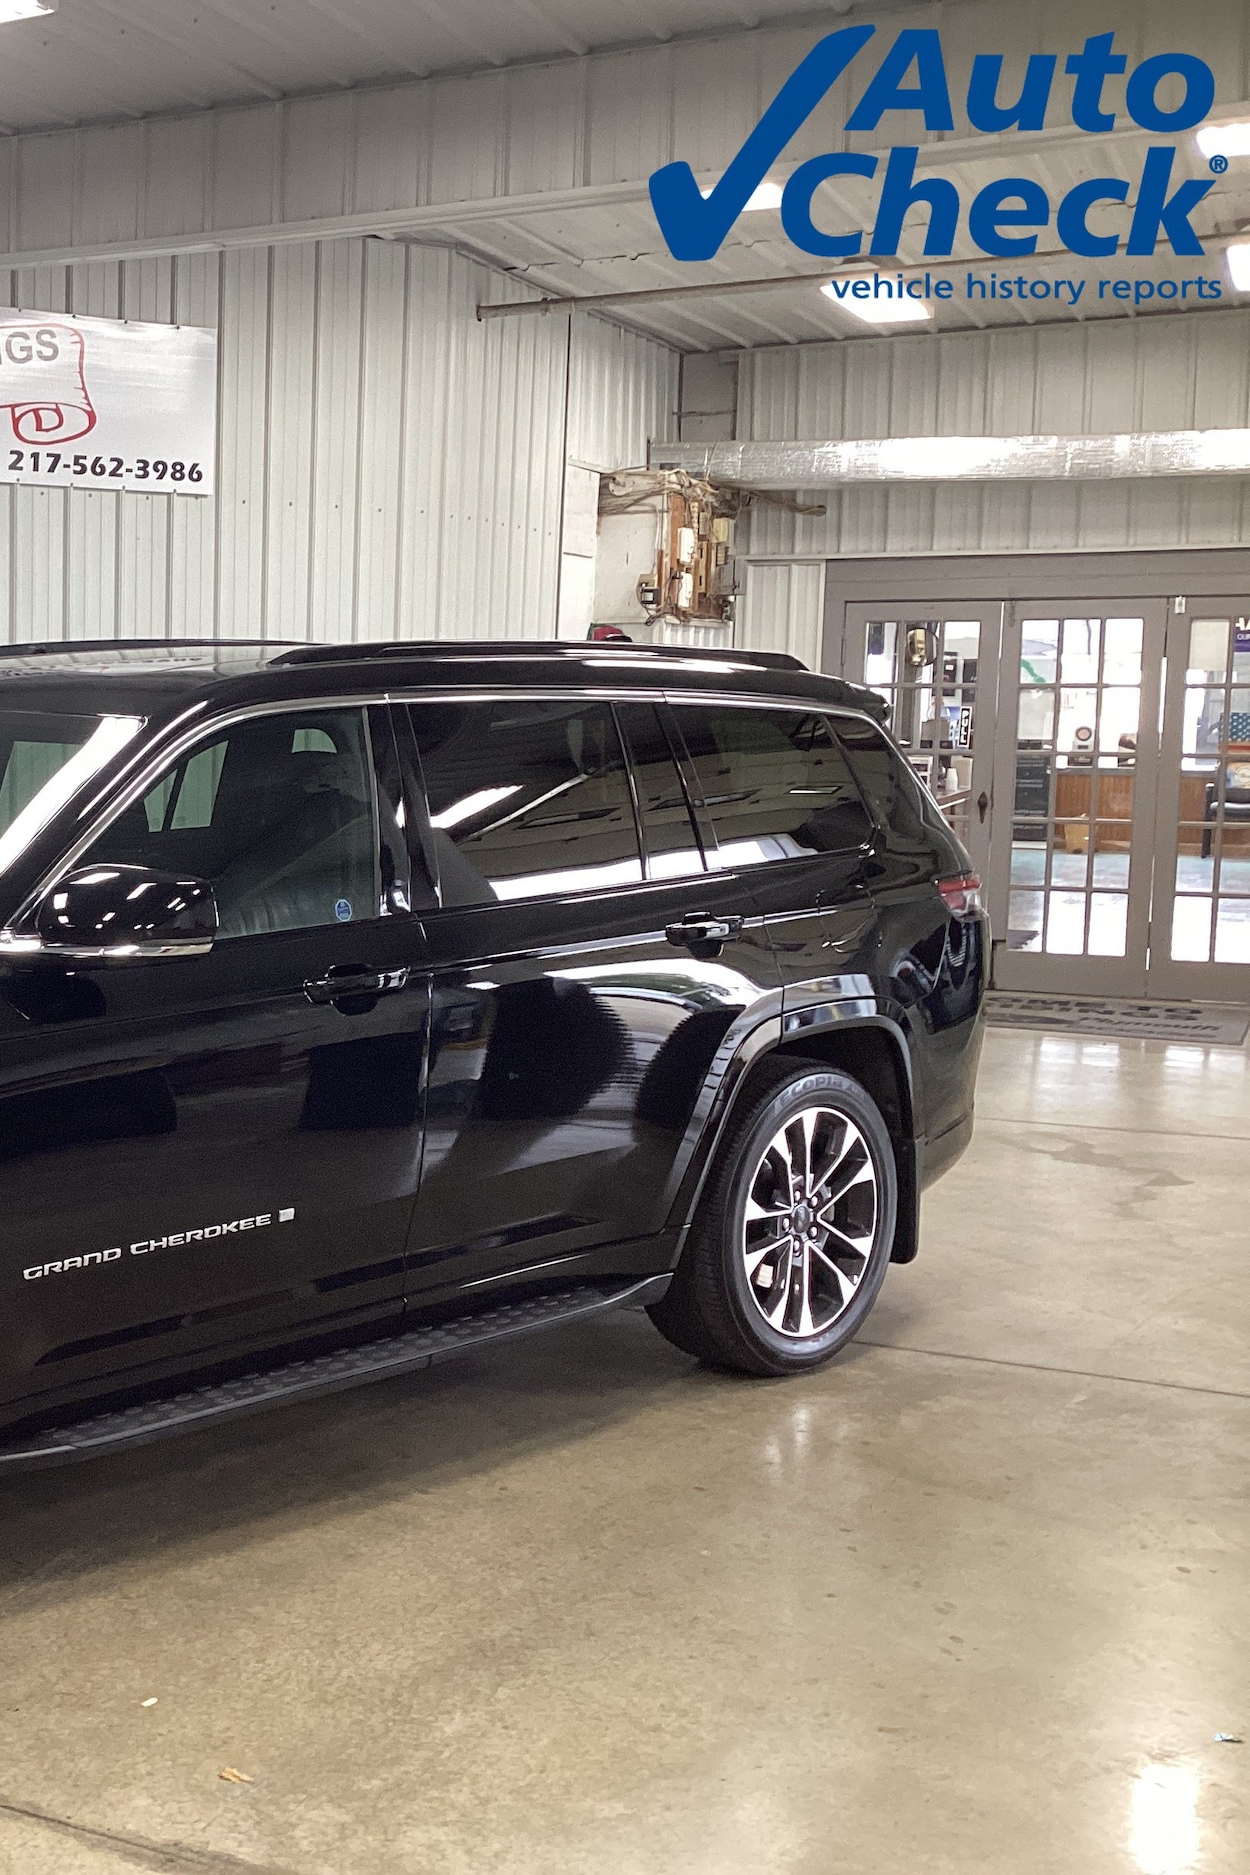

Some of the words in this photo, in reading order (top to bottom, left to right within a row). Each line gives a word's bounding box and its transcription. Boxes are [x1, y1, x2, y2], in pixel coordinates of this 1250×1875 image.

[8, 449, 204, 483] 217-562-3986
[960, 709, 970, 744] PULL
[22, 1247, 122, 1281] GRAND
[129, 1213, 272, 1256] CHEROKEE
